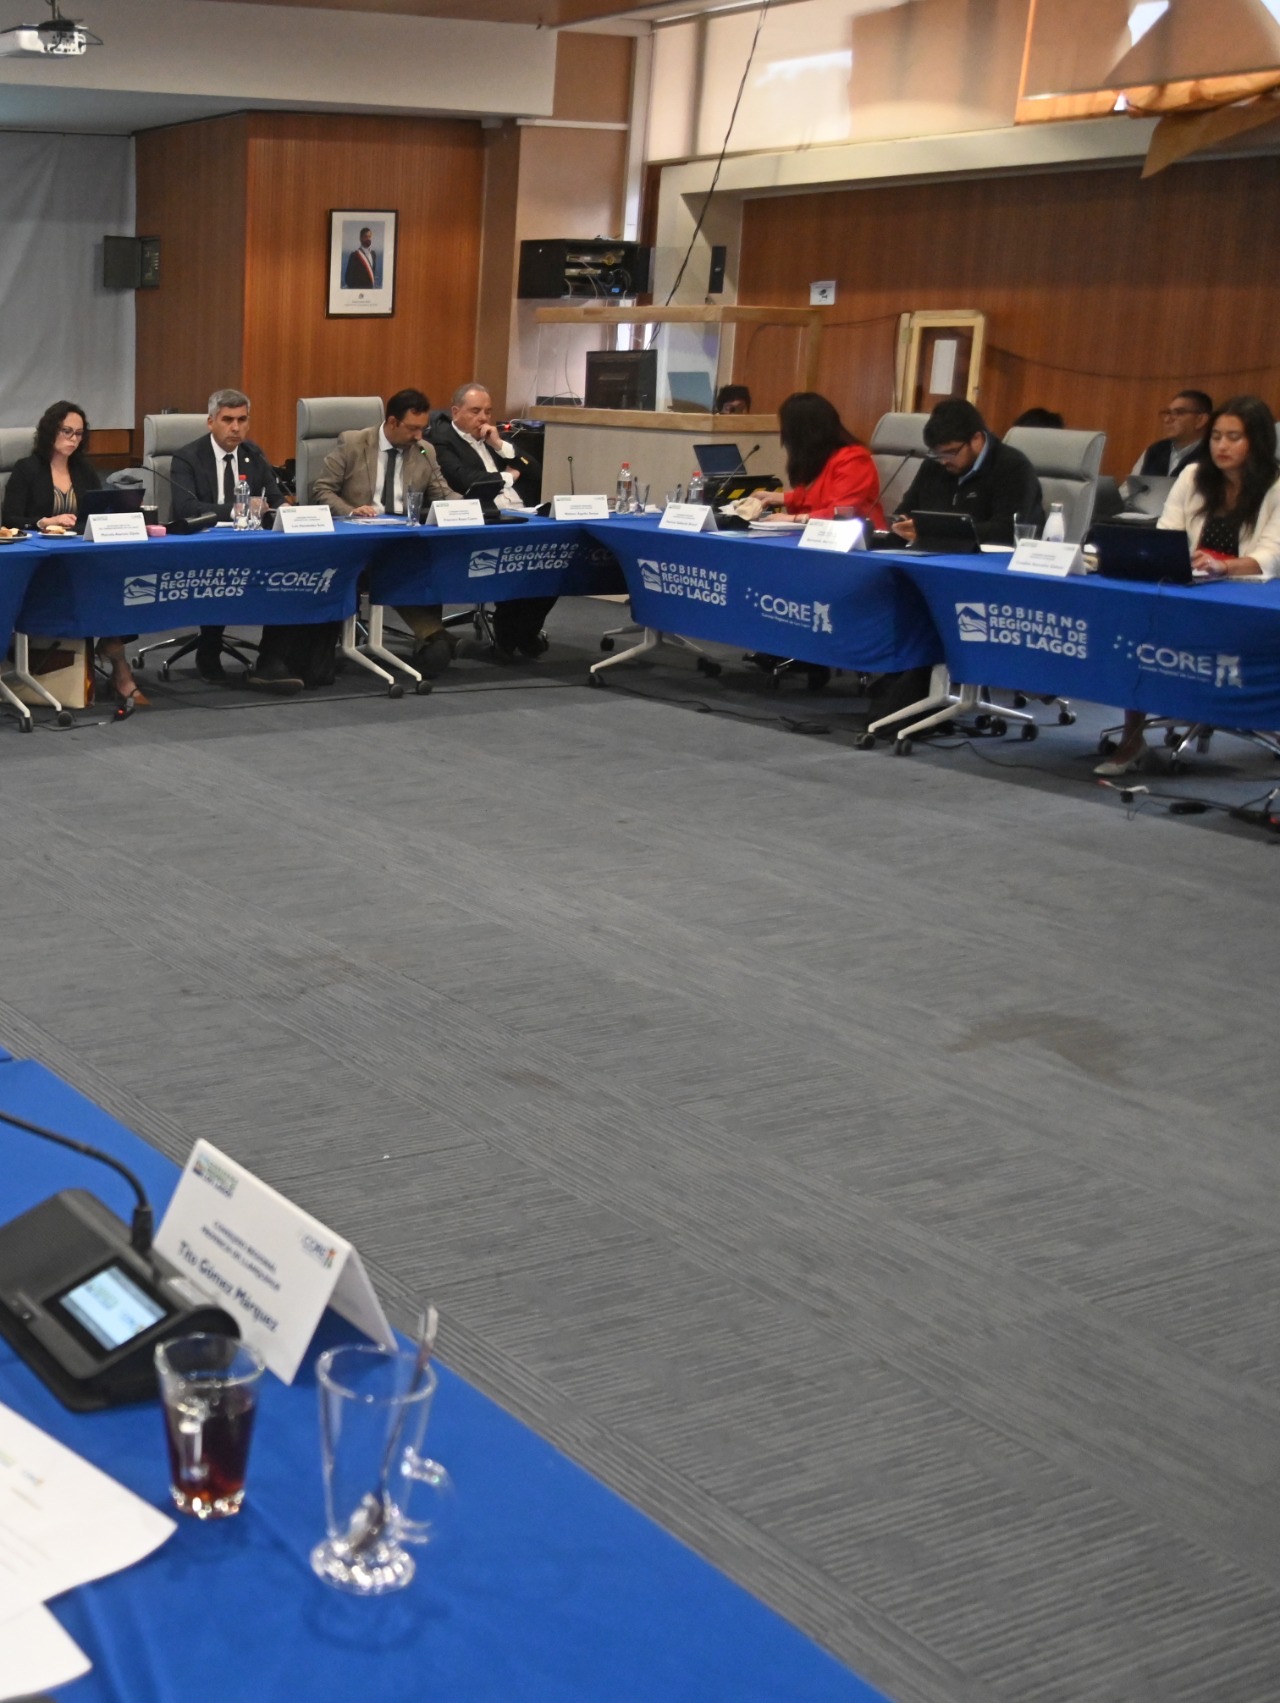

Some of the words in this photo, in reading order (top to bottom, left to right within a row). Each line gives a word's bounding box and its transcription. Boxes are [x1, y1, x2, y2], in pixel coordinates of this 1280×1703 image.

[500, 552, 556, 562] REGIONAL
[503, 543, 579, 554] GOBIERNO
[161, 568, 251, 580] GOBIERNO
[498, 561, 524, 574] LOS
[527, 560, 569, 570] LAGOS
[661, 562, 727, 582] GOBIERNO
[160, 577, 227, 590] REGIONAL
[231, 577, 248, 585] DE
[268, 572, 321, 586] CORE
[662, 572, 710, 590] REGIONAL
[714, 582, 727, 594] DE
[159, 589, 188, 602] LOS
[194, 586, 244, 598] LAGOS
[663, 582, 684, 596] LOS
[687, 587, 727, 606] LAGOS
[760, 594, 811, 621] CORE
[988, 603, 1087, 631] GOBIERNO
[989, 616, 1062, 639] REGIONAL
[1067, 630, 1087, 644] DE
[990, 629, 1021, 646] LOS
[1026, 634, 1087, 659] LAGOS
[1136, 644, 1212, 675] CORE
[178, 1240, 198, 1267] Tito
[199, 1259, 235, 1294] Gómez
[236, 1286, 280, 1332] Márquez
